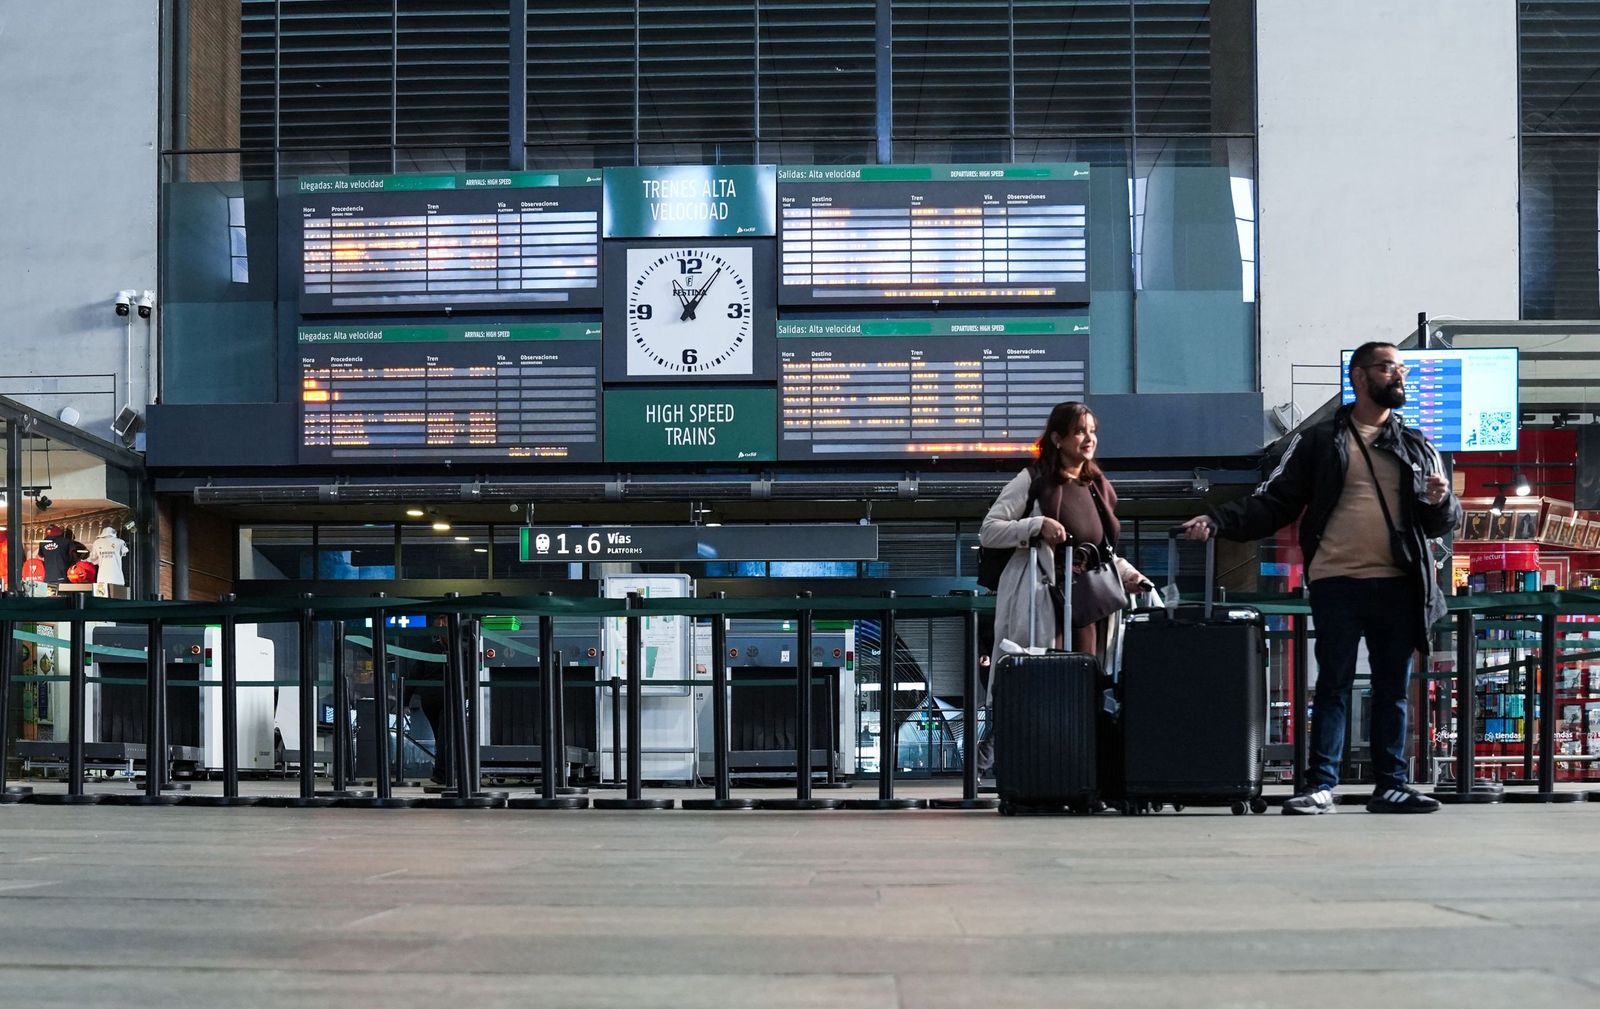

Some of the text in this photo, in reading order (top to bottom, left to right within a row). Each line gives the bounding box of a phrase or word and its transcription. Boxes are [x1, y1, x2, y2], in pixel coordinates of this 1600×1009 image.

[778, 170, 861, 179] Salidas: Alta velocidad
[300, 179, 384, 191] Llegadas: Alta velocidad
[642, 179, 736, 198] TRENES ALTA
[650, 202, 729, 220] VELOCIDAD
[677, 258, 702, 274] 12
[637, 304, 652, 320] 9
[728, 303, 742, 318] 3
[300, 330, 382, 341] Llegadas: Alta velocidad
[778, 324, 861, 334] Salidas: Alta velocidad
[682, 349, 698, 364] 6
[646, 404, 734, 423] HIGH SPEED
[664, 427, 716, 445] TRAINS
[557, 533, 600, 554] 1 a 6
[608, 532, 631, 544] Vías
